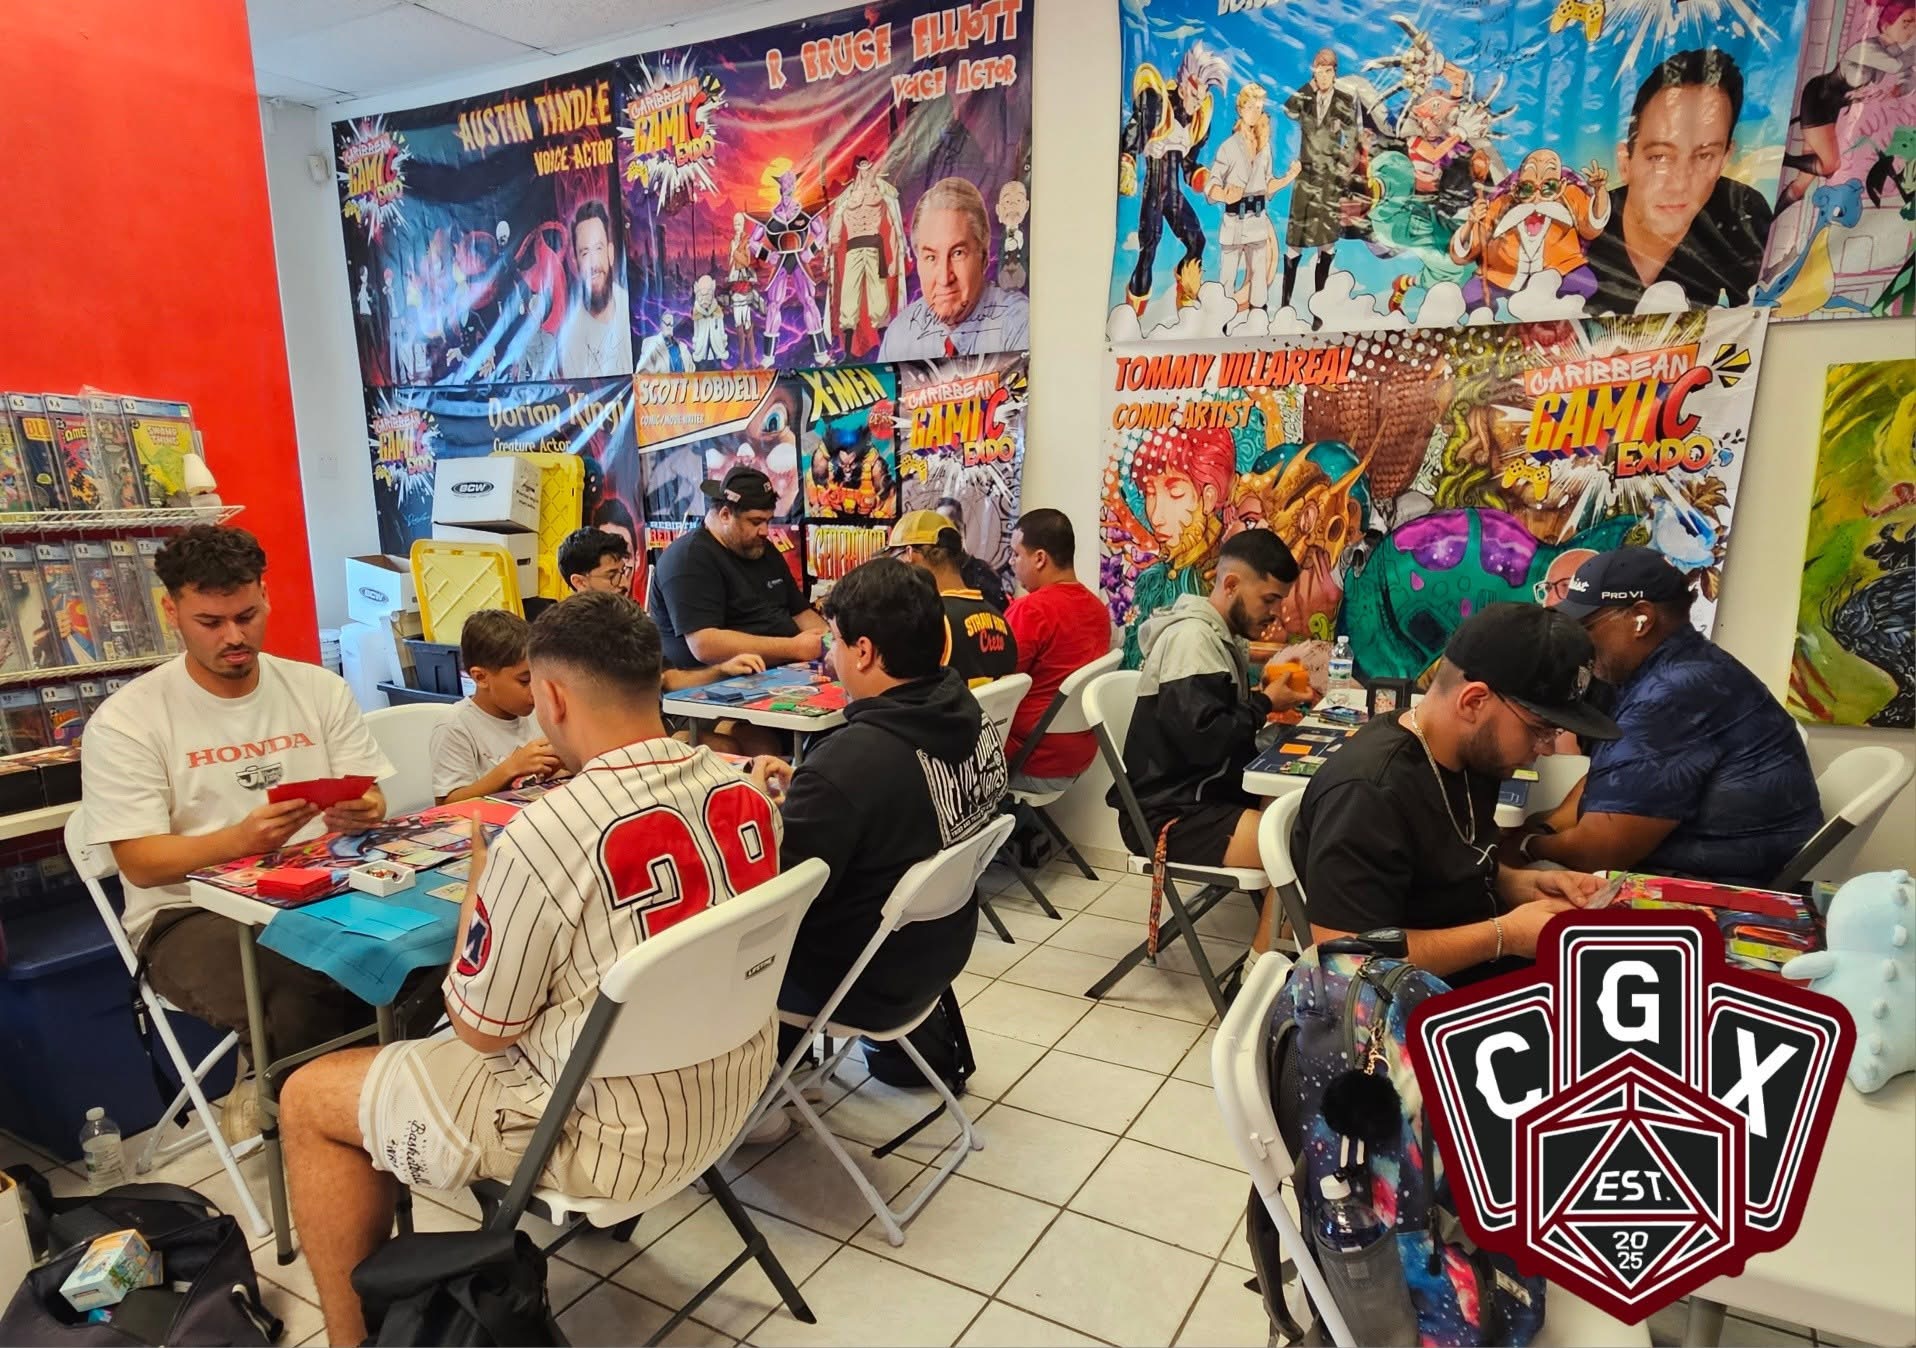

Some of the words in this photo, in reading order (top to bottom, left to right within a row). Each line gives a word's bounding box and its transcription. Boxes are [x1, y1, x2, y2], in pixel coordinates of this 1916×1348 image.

[765, 48, 787, 90] R
[800, 22, 892, 82] BRUCE
[911, 0, 1022, 60] ELLIOTT
[891, 66, 947, 109] VOICE
[956, 54, 1018, 95] ACTOR
[459, 99, 534, 152] AUSTIN
[534, 82, 613, 137] TINDLE
[630, 82, 700, 121] CARIBBEAN
[633, 91, 707, 154] GAMIC
[533, 147, 570, 176] VOICE
[572, 139, 615, 168] ACTOR
[674, 138, 715, 168] EXPO
[1114, 353, 1216, 392] TOMMY
[1217, 346, 1355, 388] VILLAREAL
[1529, 353, 1688, 397] CARIBBEAN
[638, 380, 690, 407] SCOTT
[692, 374, 761, 405] LOBDELL
[802, 366, 888, 424] X-MEN
[904, 378, 995, 410] CARIBBEAN
[1525, 365, 1713, 454] GAMIC
[488, 396, 561, 433] Dorian
[910, 387, 1008, 452] GAMIC
[1111, 401, 1176, 431] COMIC
[1180, 400, 1254, 429] ARTIST
[493, 437, 536, 453] Creature
[539, 437, 572, 453] Actor
[962, 435, 1015, 468] EXPO
[1614, 436, 1715, 480] EXPO
[459, 483, 486, 493] BCW
[1601, 591, 1627, 599] PRO
[186, 732, 316, 768] HONDA
